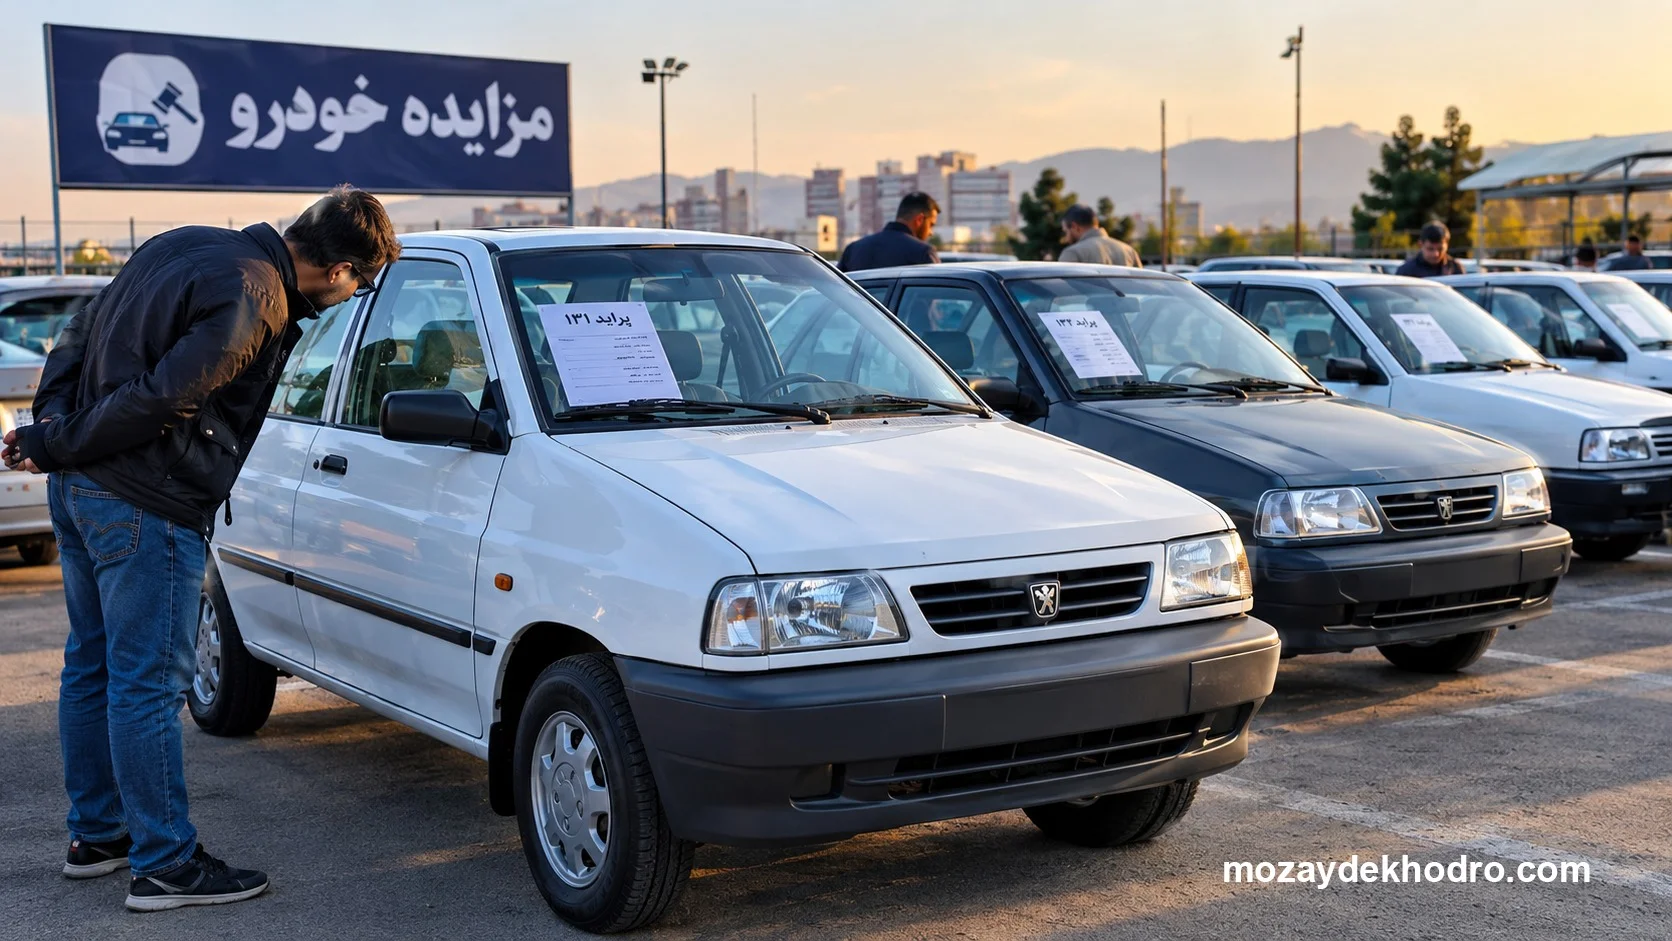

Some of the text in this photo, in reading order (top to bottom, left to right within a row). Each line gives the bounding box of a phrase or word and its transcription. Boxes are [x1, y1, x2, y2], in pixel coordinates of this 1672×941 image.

[226, 74, 554, 157] مزایده خودرو
[565, 312, 632, 327] پراید ۱۳۱
